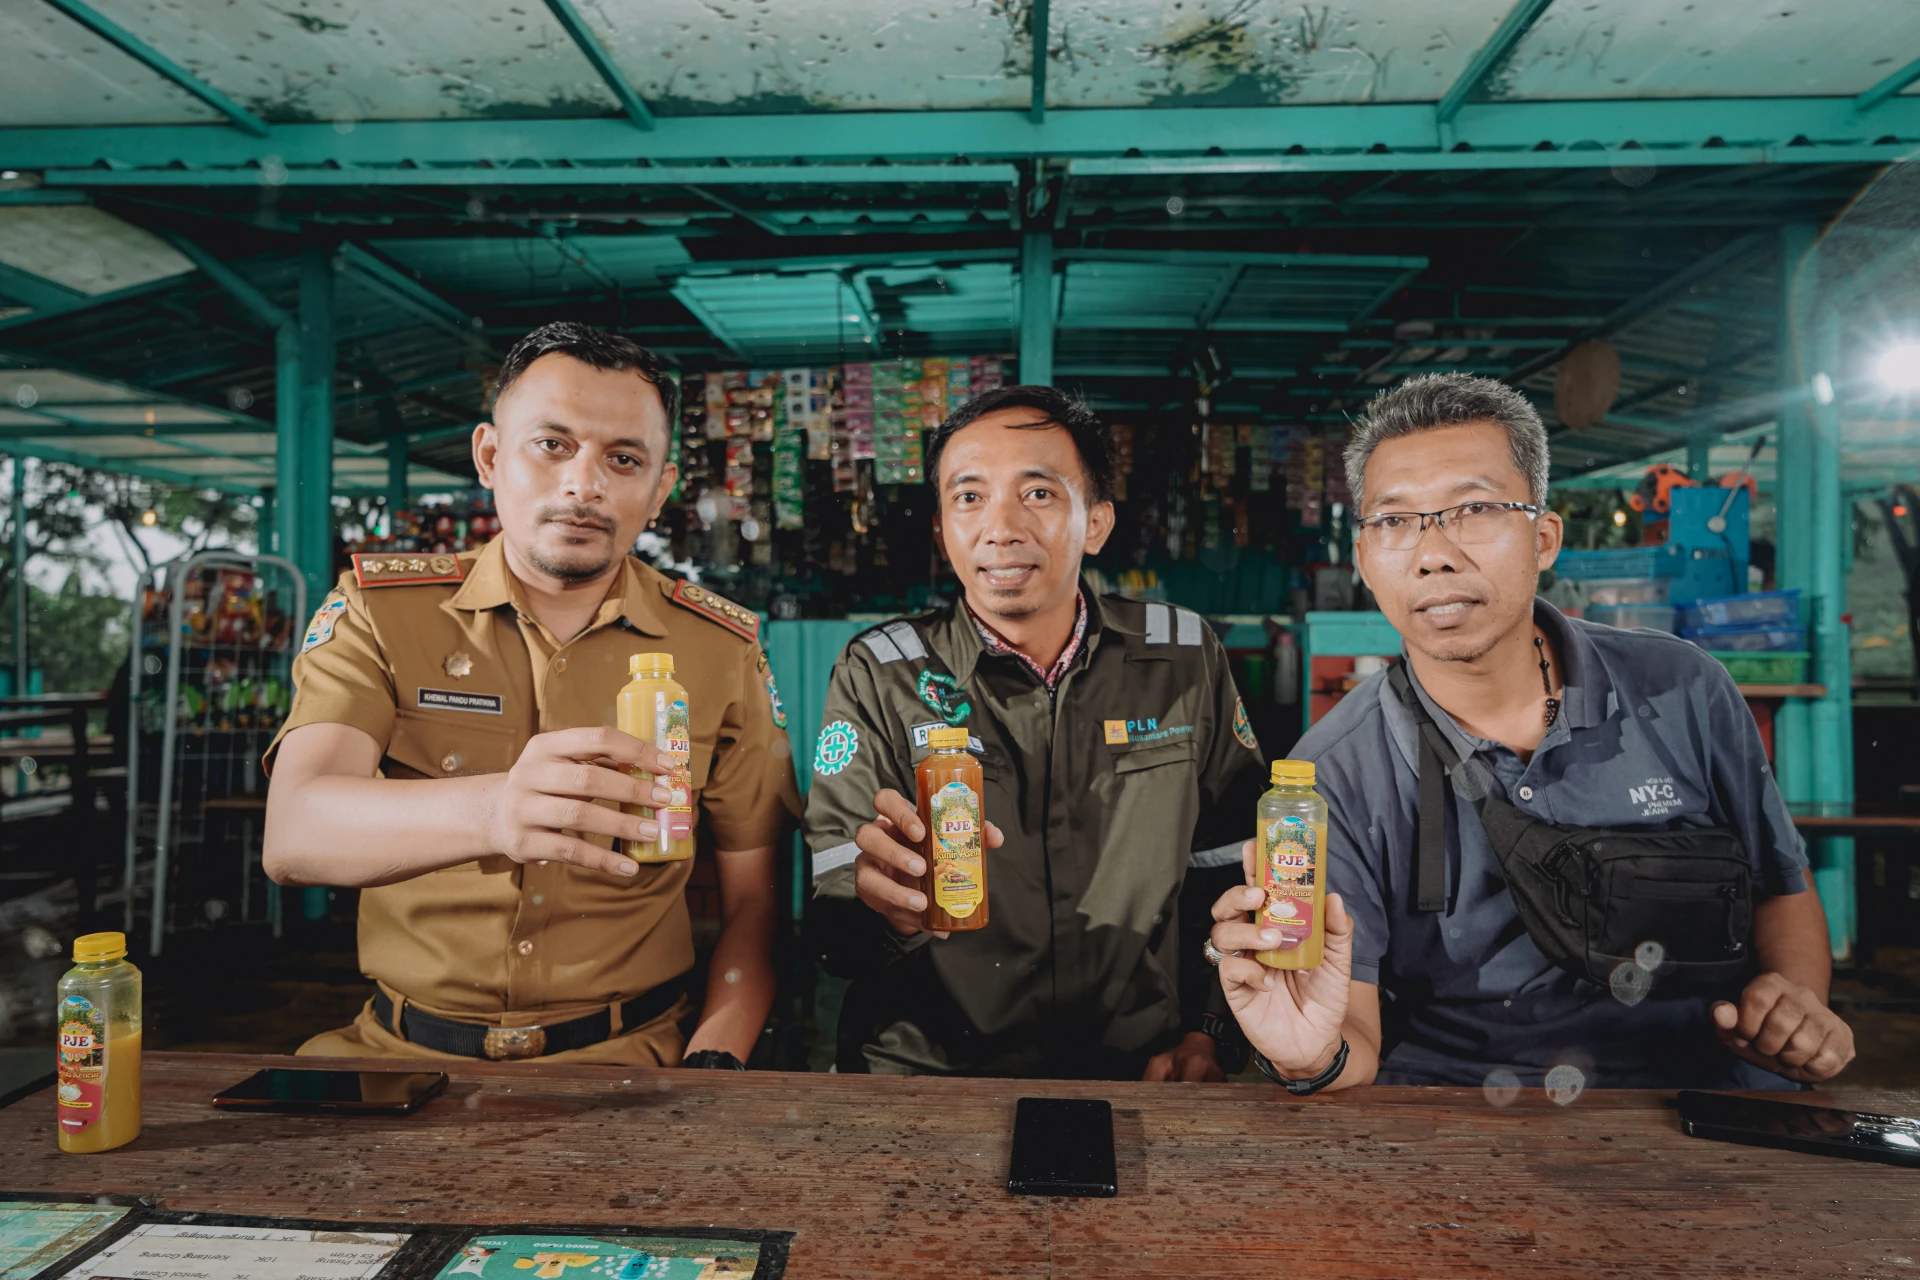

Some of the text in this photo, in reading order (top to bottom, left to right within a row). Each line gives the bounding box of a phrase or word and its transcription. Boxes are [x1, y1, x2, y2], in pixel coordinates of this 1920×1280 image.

[424, 693, 497, 707] KHEMAL PANDU PRATIKNA
[1126, 718, 1158, 733] PLN
[1129, 730, 1169, 743] Nusantara
[1169, 725, 1193, 736] Power
[1629, 784, 1675, 804] NY-C
[1648, 798, 1683, 808] PREMIUM
[945, 820, 971, 832] PJE
[1277, 854, 1304, 866] PJE
[63, 1034, 89, 1047] PJE
[73, 1069, 101, 1079] Kencur
[138, 1251, 182, 1260] Goreng
[184, 1252, 230, 1262] Kentang
[315, 1256, 352, 1266] Pisang
[329, 1252, 358, 1260] Krim
